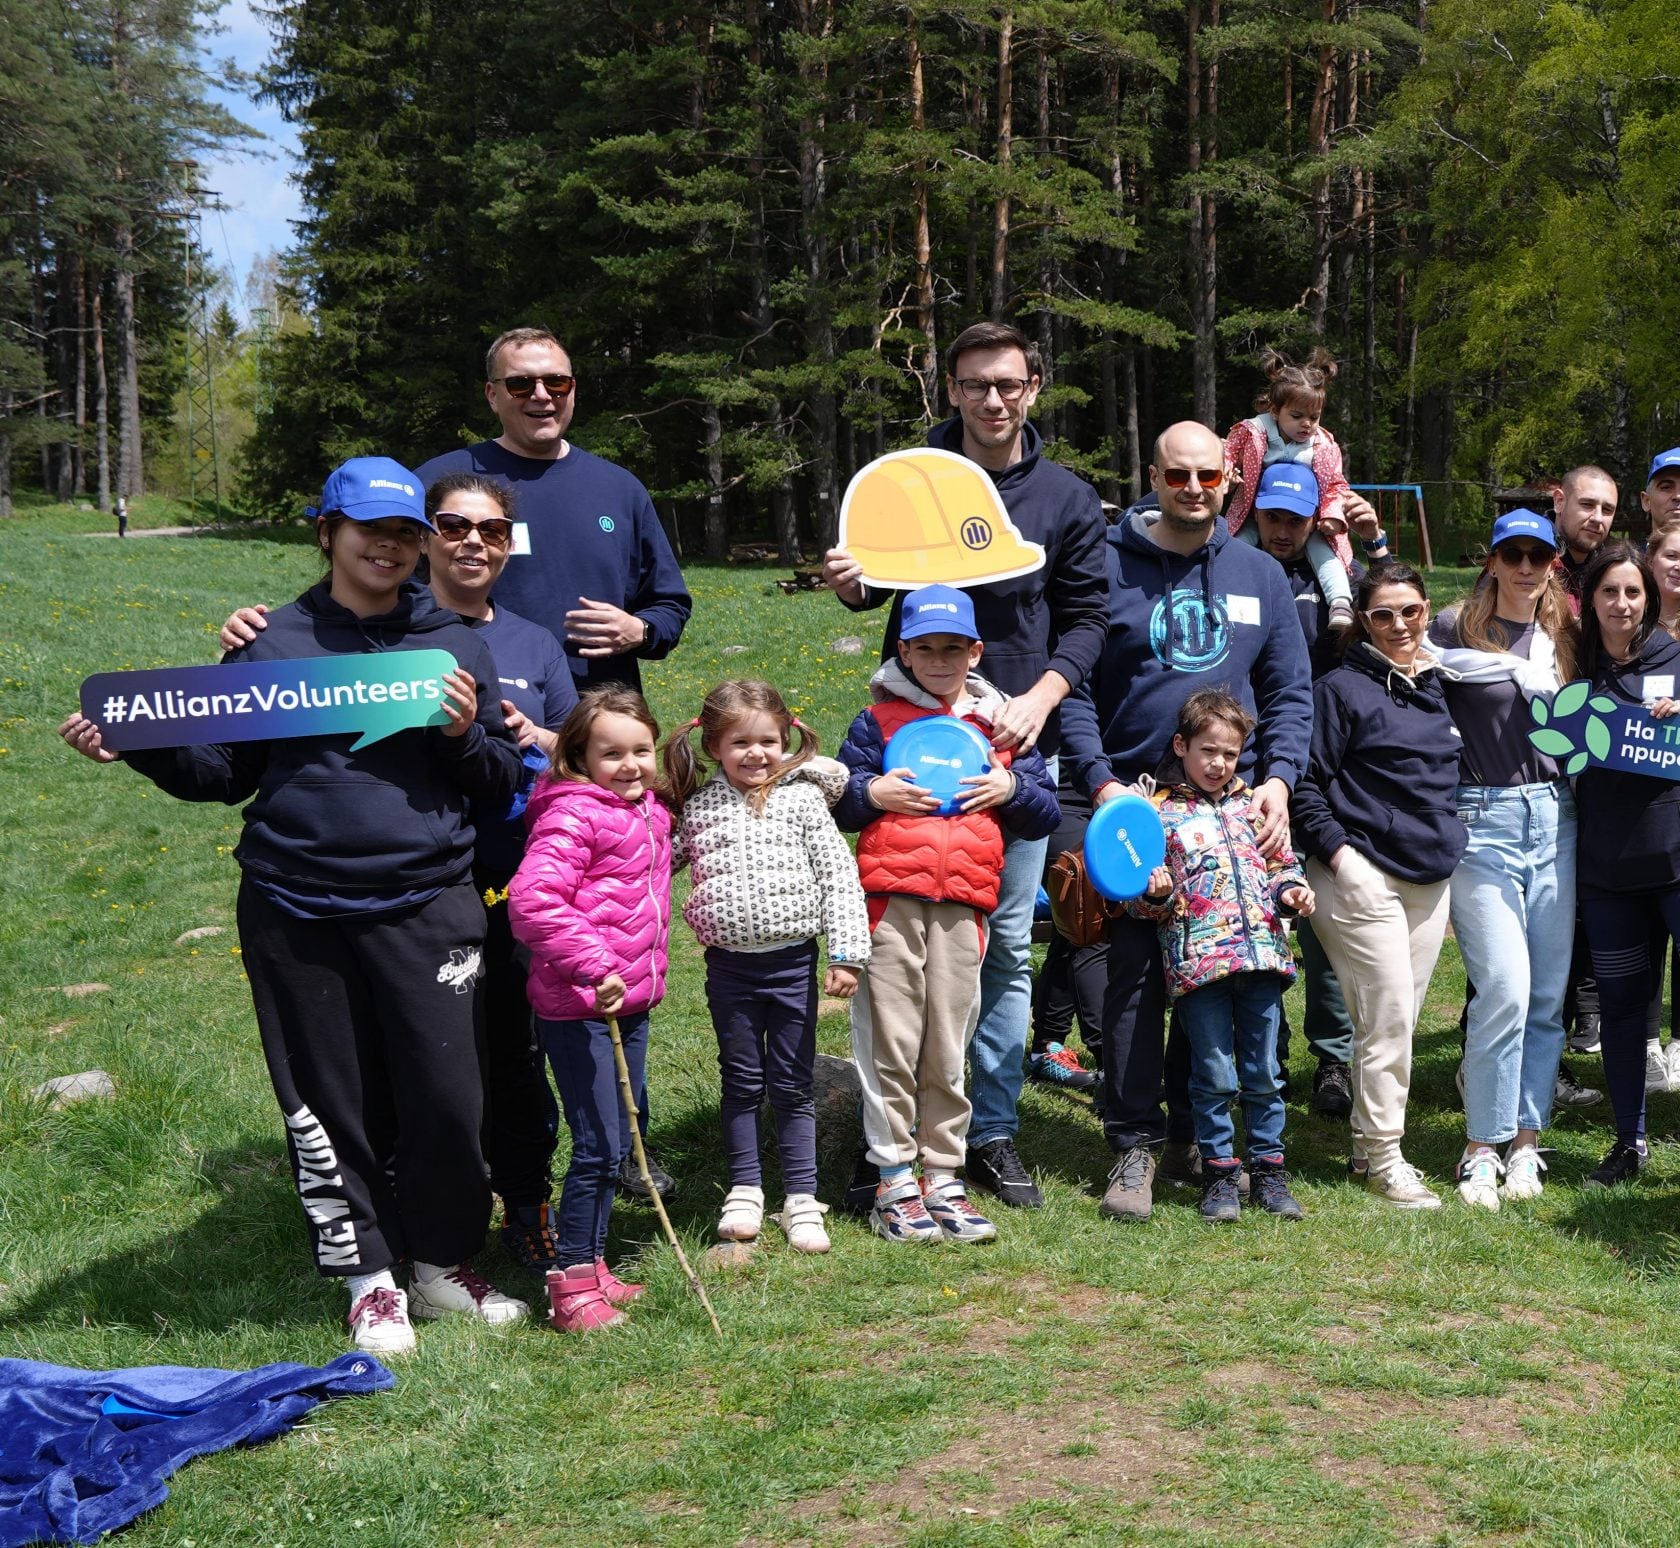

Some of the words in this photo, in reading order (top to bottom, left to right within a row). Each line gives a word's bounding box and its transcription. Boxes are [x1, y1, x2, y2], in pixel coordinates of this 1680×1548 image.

[370, 480, 404, 491] Allianz
[1273, 481, 1293, 489] Allianz
[919, 603, 946, 613] Allianz
[103, 677, 440, 723] #AllianzVolunteers
[1624, 719, 1655, 741] На
[919, 755, 951, 766] Allianz
[1123, 838, 1142, 868] Allianz
[283, 1103, 343, 1194] YORK
[301, 1198, 361, 1267] NEW
